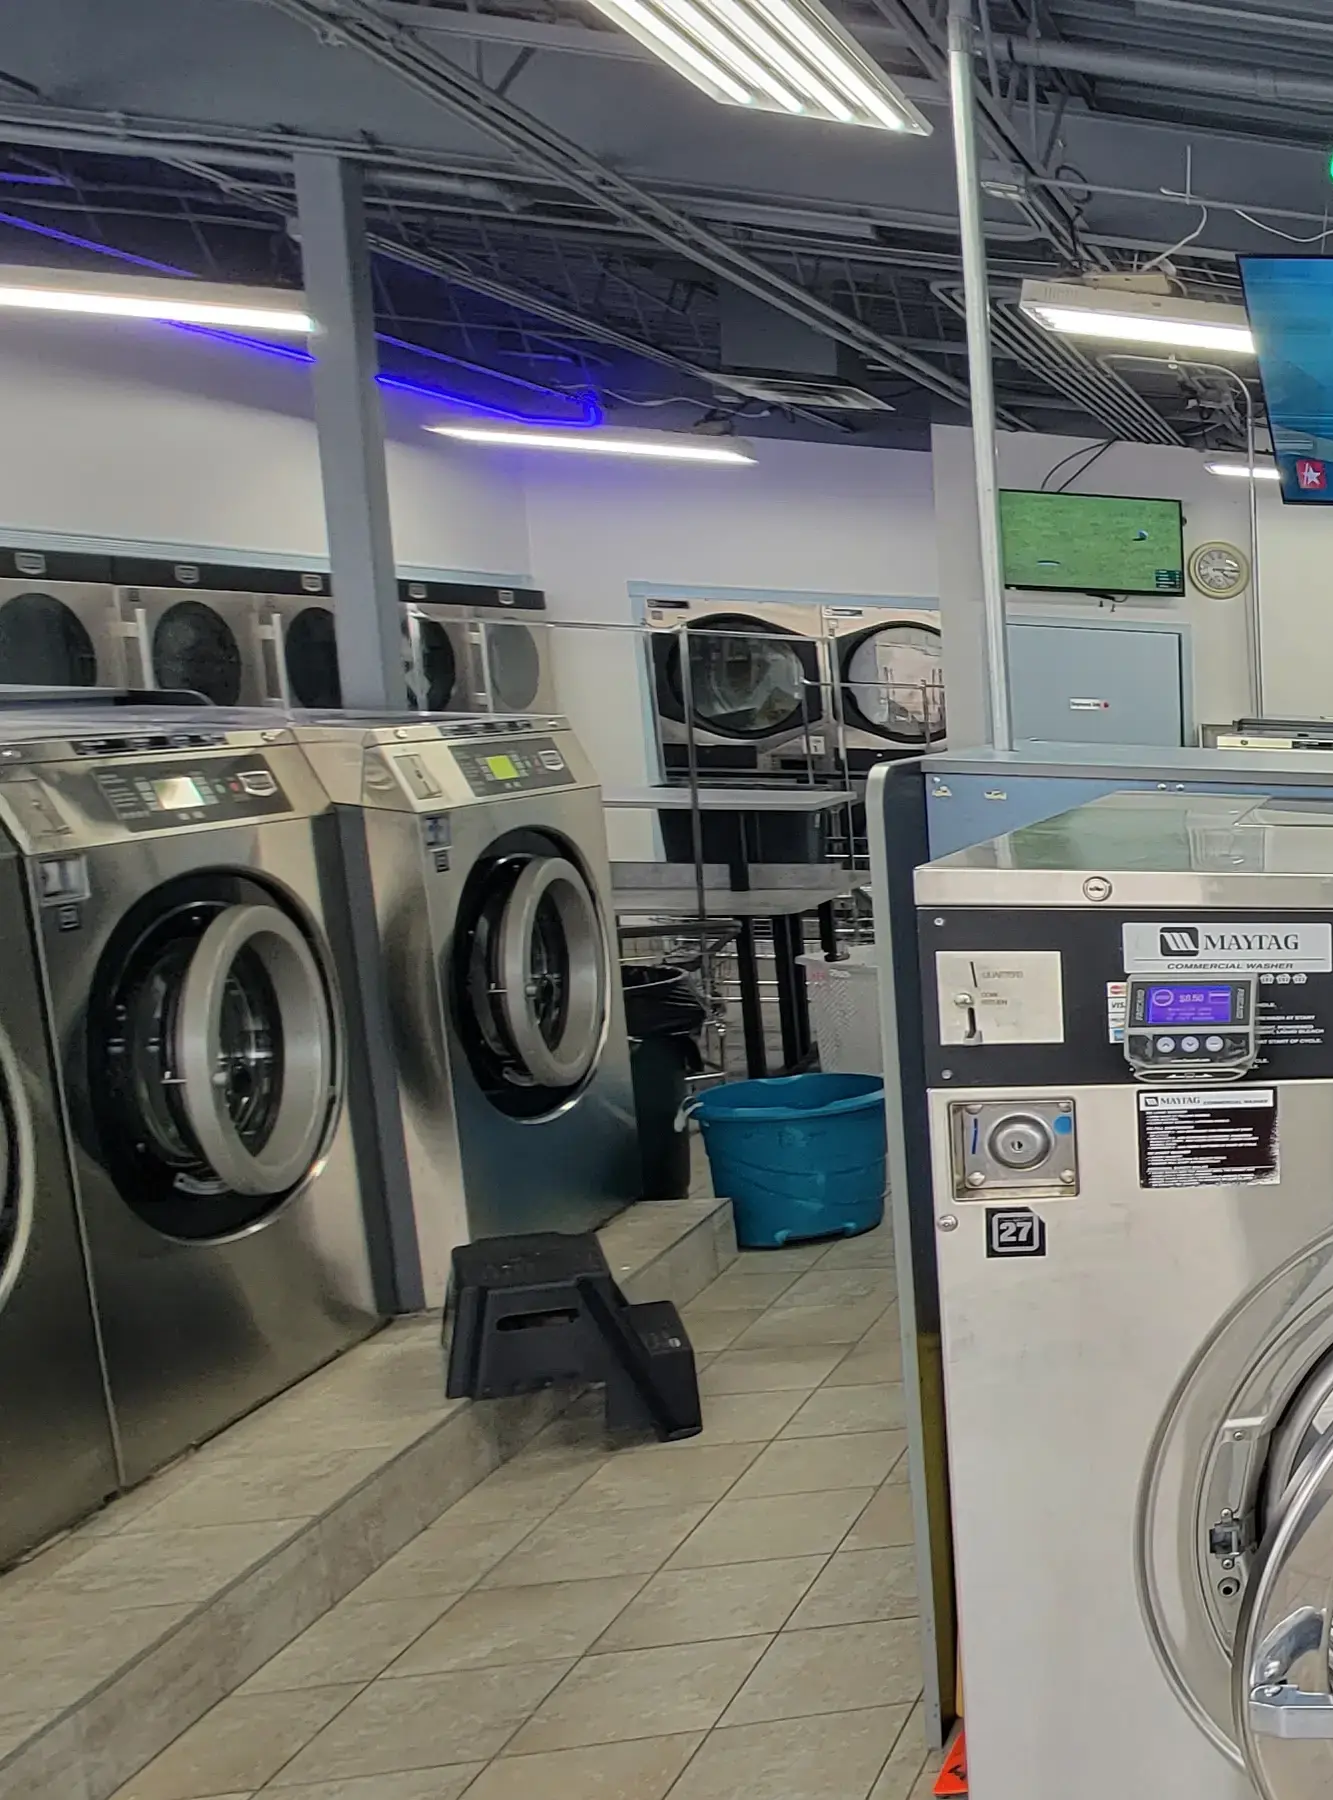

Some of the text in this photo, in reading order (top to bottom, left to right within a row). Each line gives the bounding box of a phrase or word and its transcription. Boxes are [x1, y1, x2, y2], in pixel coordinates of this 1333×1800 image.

[1203, 934, 1299, 951] MAYTAG
[1160, 1097, 1200, 1105] MAYTAG
[999, 1221, 1033, 1242] 27
